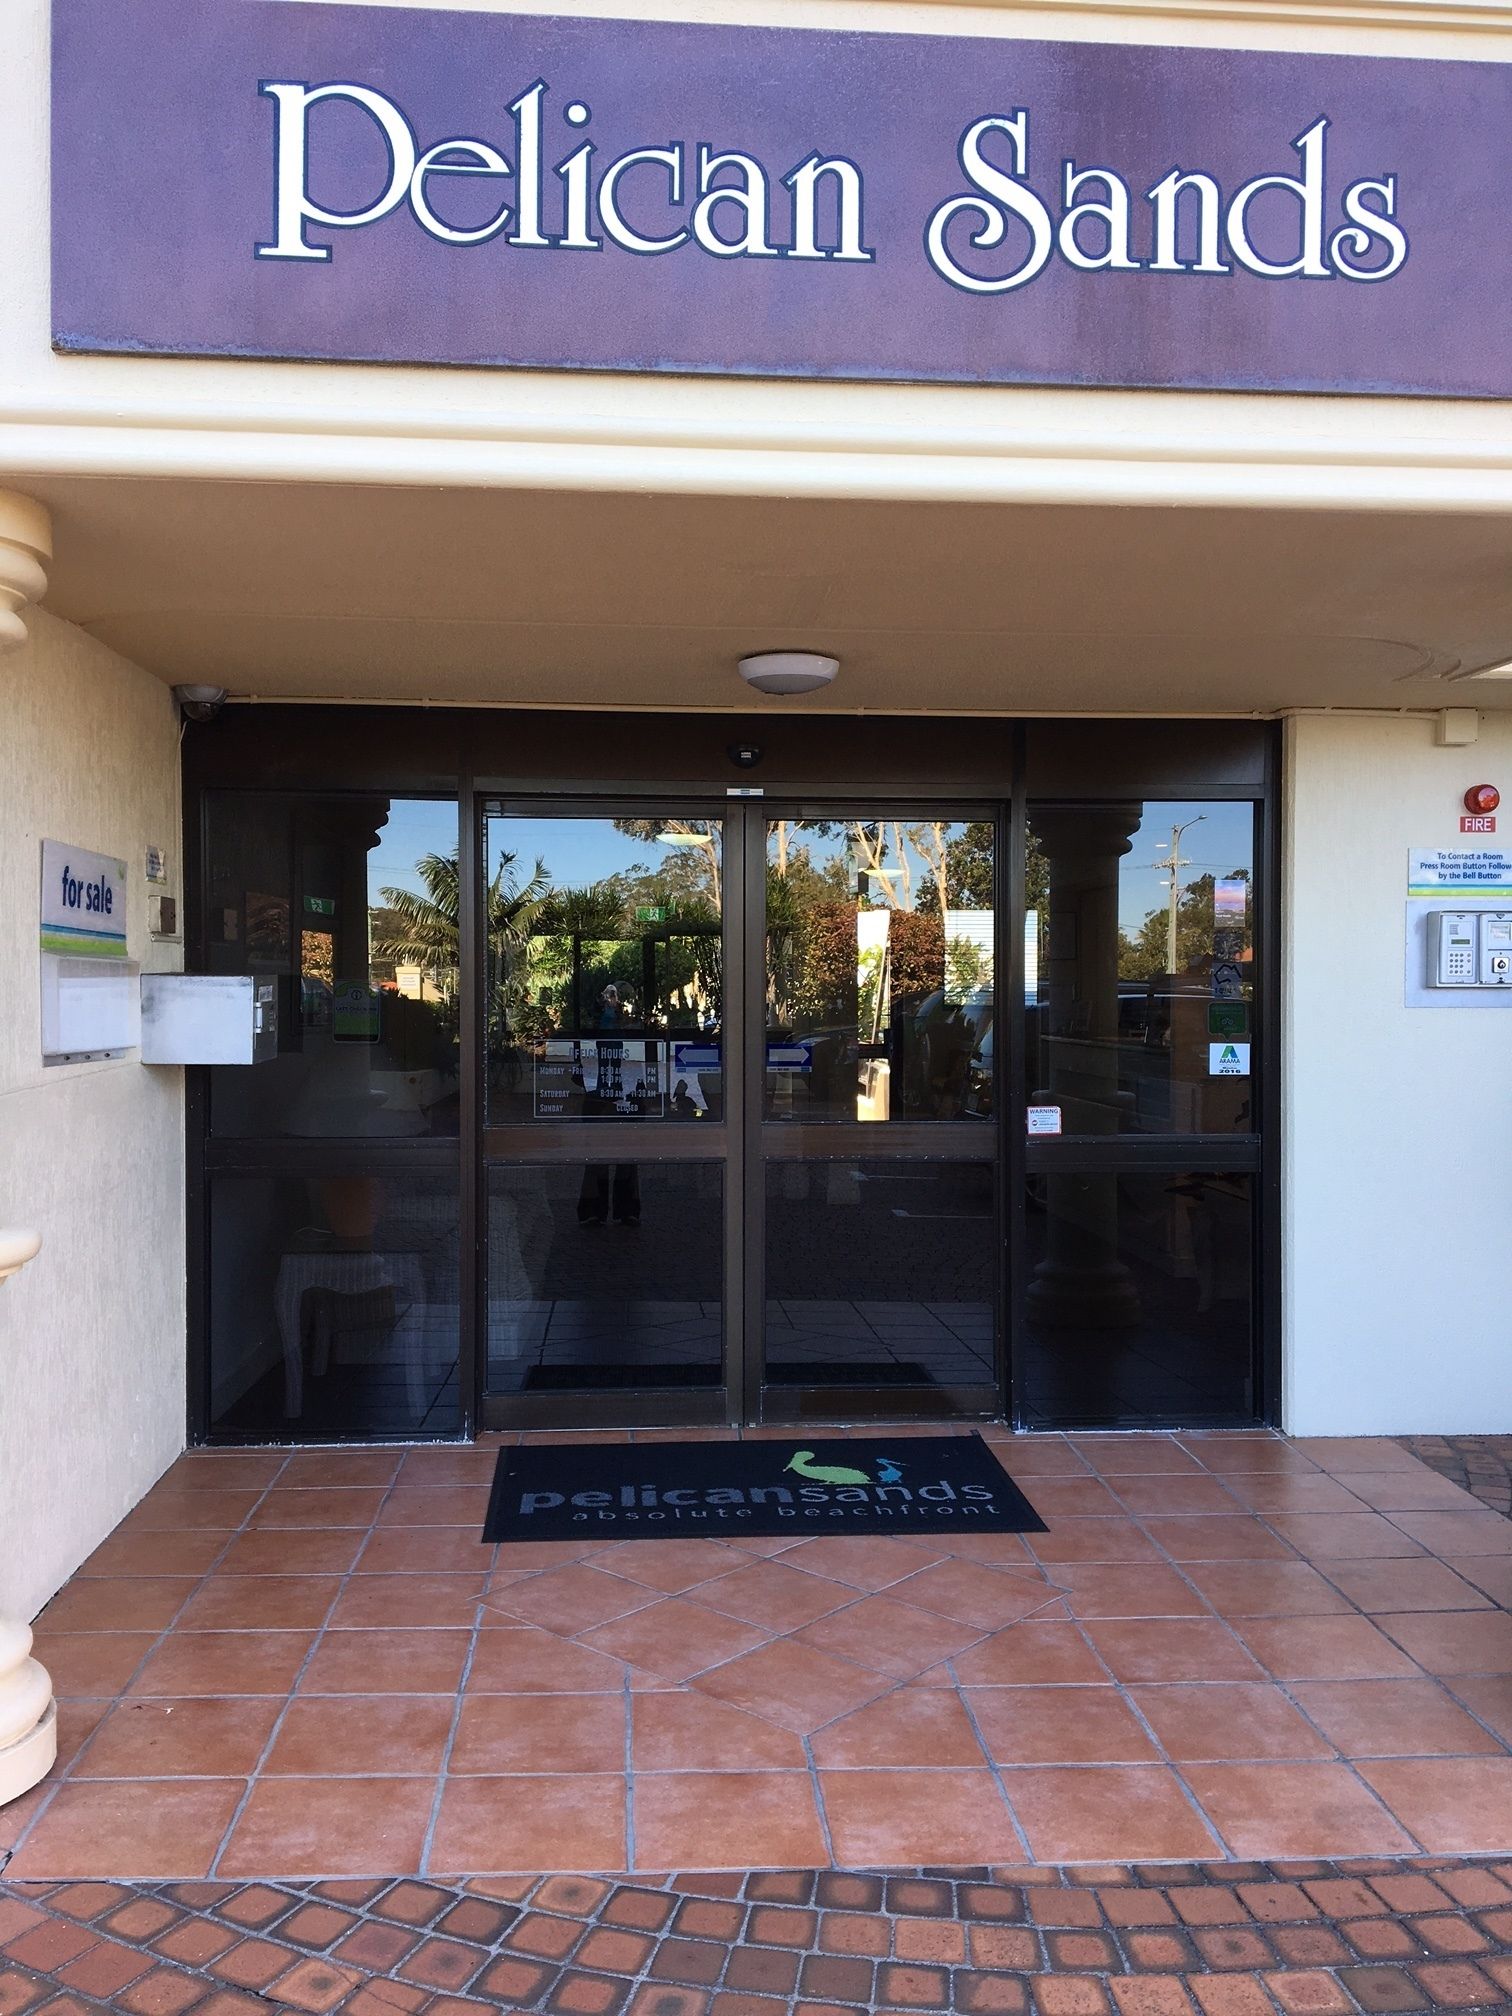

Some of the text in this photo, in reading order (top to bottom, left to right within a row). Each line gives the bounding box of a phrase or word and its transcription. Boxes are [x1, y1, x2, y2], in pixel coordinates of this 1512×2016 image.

[254, 79, 1412, 295] Pelican Sands
[1465, 818, 1492, 831] FIRE
[1438, 852, 1447, 860] To
[1448, 852, 1475, 860] Contact
[1482, 852, 1503, 860] Room
[1420, 862, 1439, 870] Press
[1440, 862, 1461, 870] Room
[1462, 862, 1487, 870] Button
[1438, 872, 1447, 881] by
[62, 866, 113, 914] for sale
[540, 1089, 570, 1098] SATURDAY
[540, 1103, 563, 1112] SUNDAY
[518, 1480, 995, 1515] pelicansands
[572, 1503, 1002, 1522] absolute beachfront
